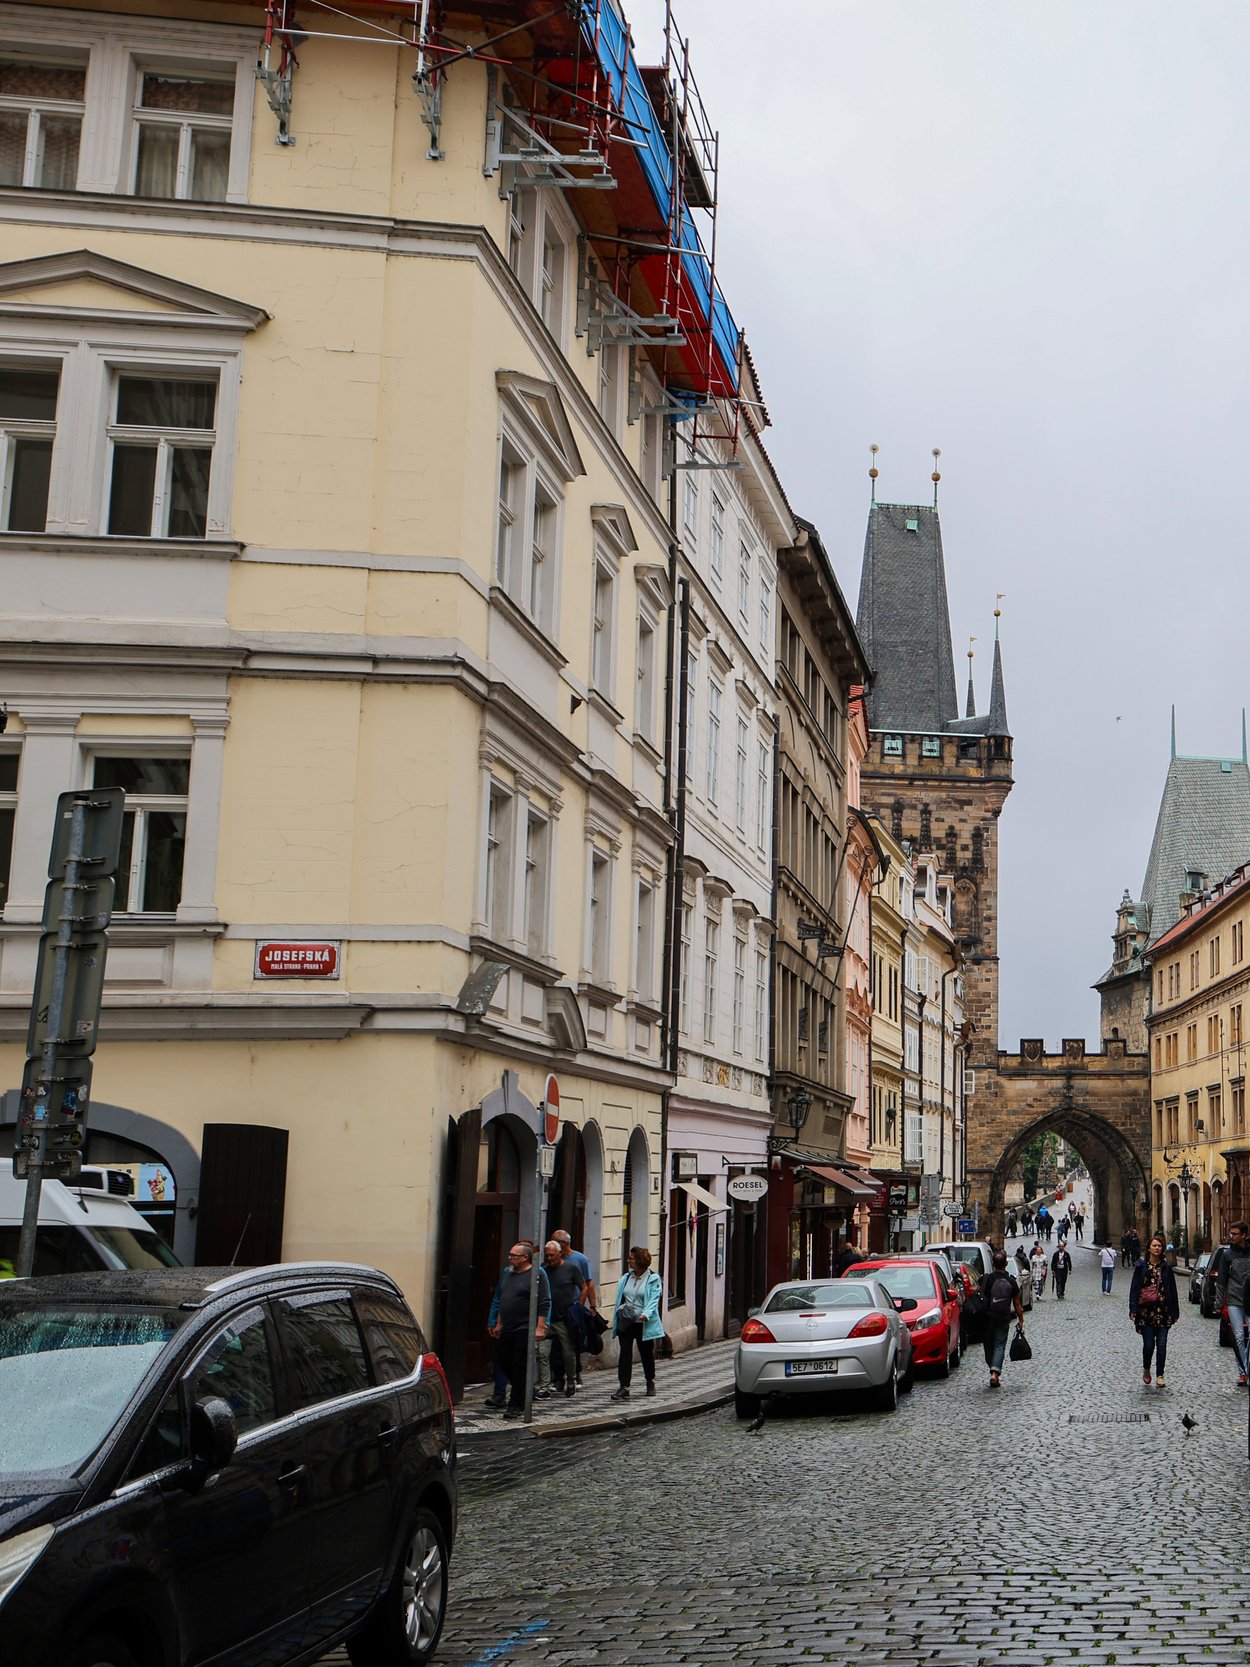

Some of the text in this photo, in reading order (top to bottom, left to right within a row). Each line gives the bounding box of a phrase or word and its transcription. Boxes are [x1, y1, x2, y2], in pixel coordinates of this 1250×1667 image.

[265, 948, 330, 962] JOSEFSKÁ
[793, 1361, 834, 1372] 5E7 0612
